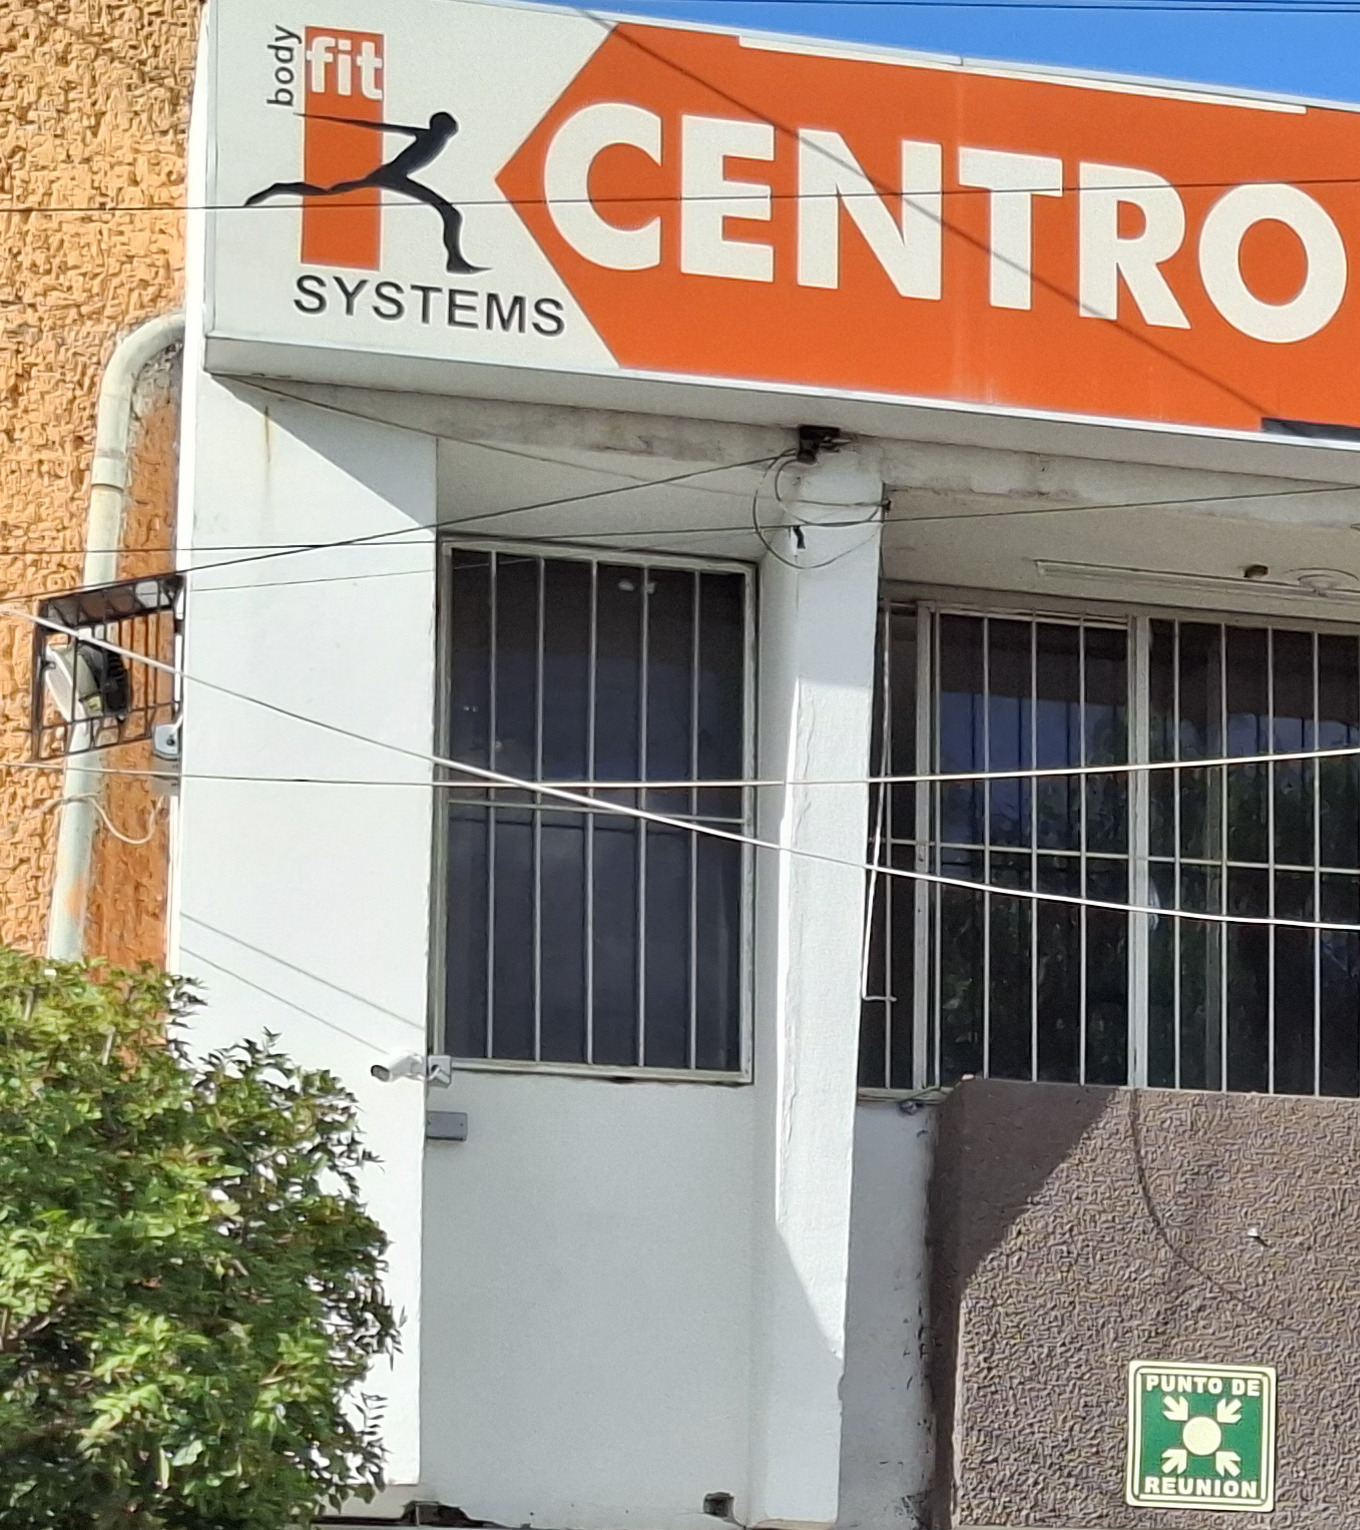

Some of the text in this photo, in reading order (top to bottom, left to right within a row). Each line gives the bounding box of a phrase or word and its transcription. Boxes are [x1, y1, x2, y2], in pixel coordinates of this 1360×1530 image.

[267, 25, 301, 107] body
[306, 36, 383, 100] fit
[543, 103, 1348, 344] CENTRO
[293, 274, 566, 337] SYSTEMS
[1146, 1375, 1261, 1397] PUNTO DE
[1144, 1476, 1257, 1498] REUNION
